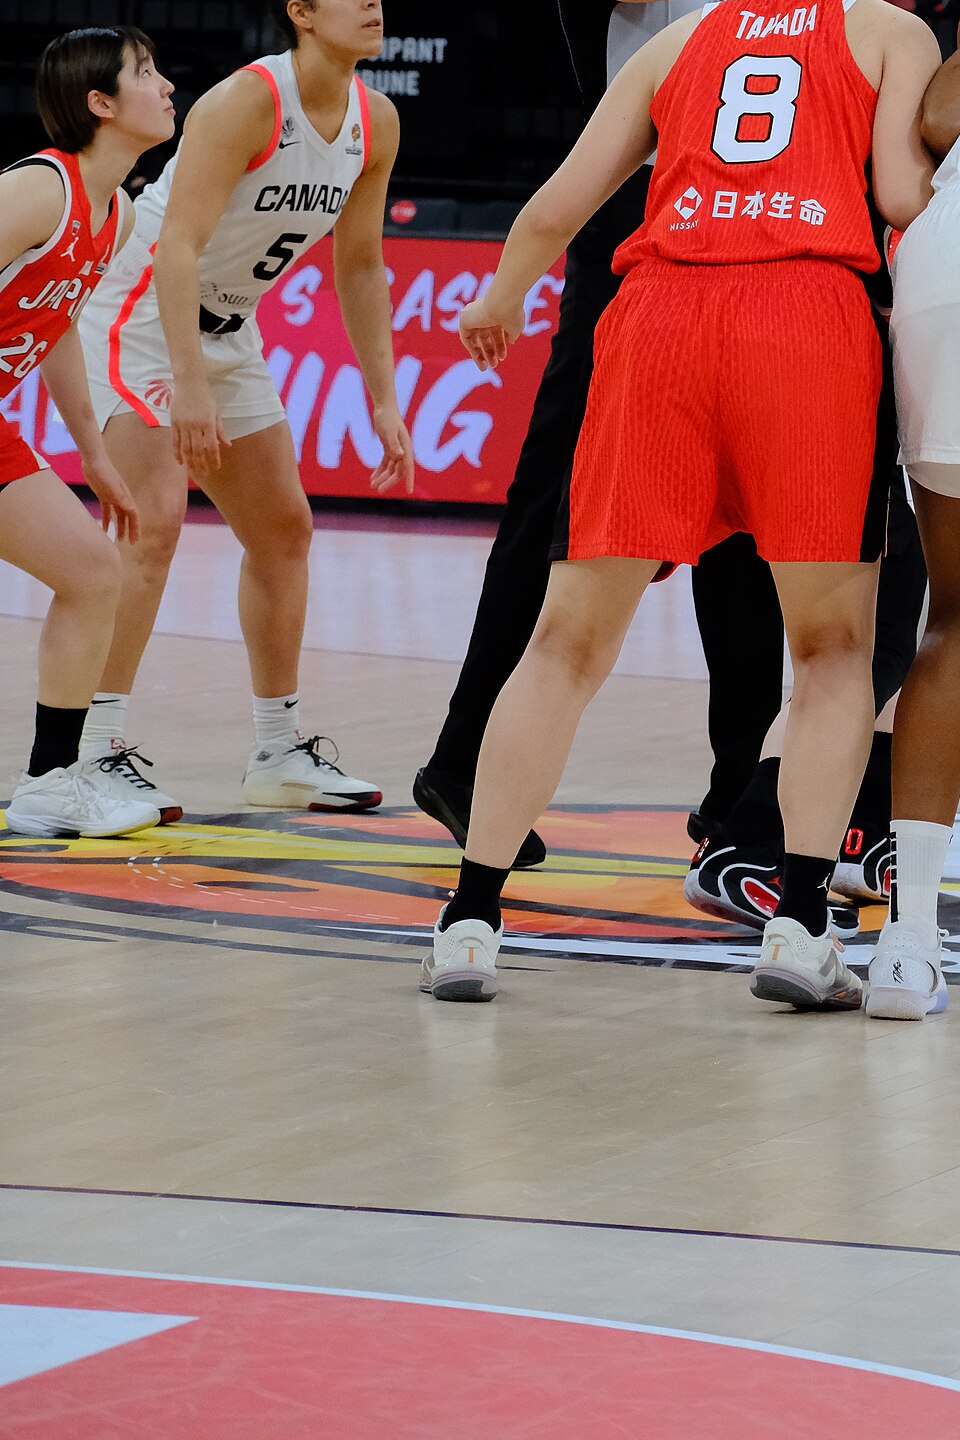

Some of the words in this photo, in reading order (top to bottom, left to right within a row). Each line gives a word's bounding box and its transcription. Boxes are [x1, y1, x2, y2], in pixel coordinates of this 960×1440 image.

[711, 53, 802, 164] 8
[254, 183, 348, 216] CANAD
[711, 190, 827, 226] 日本生命
[670, 219, 699, 231] NISSAY
[252, 232, 308, 281] 5
[0, 331, 49, 379] 26
